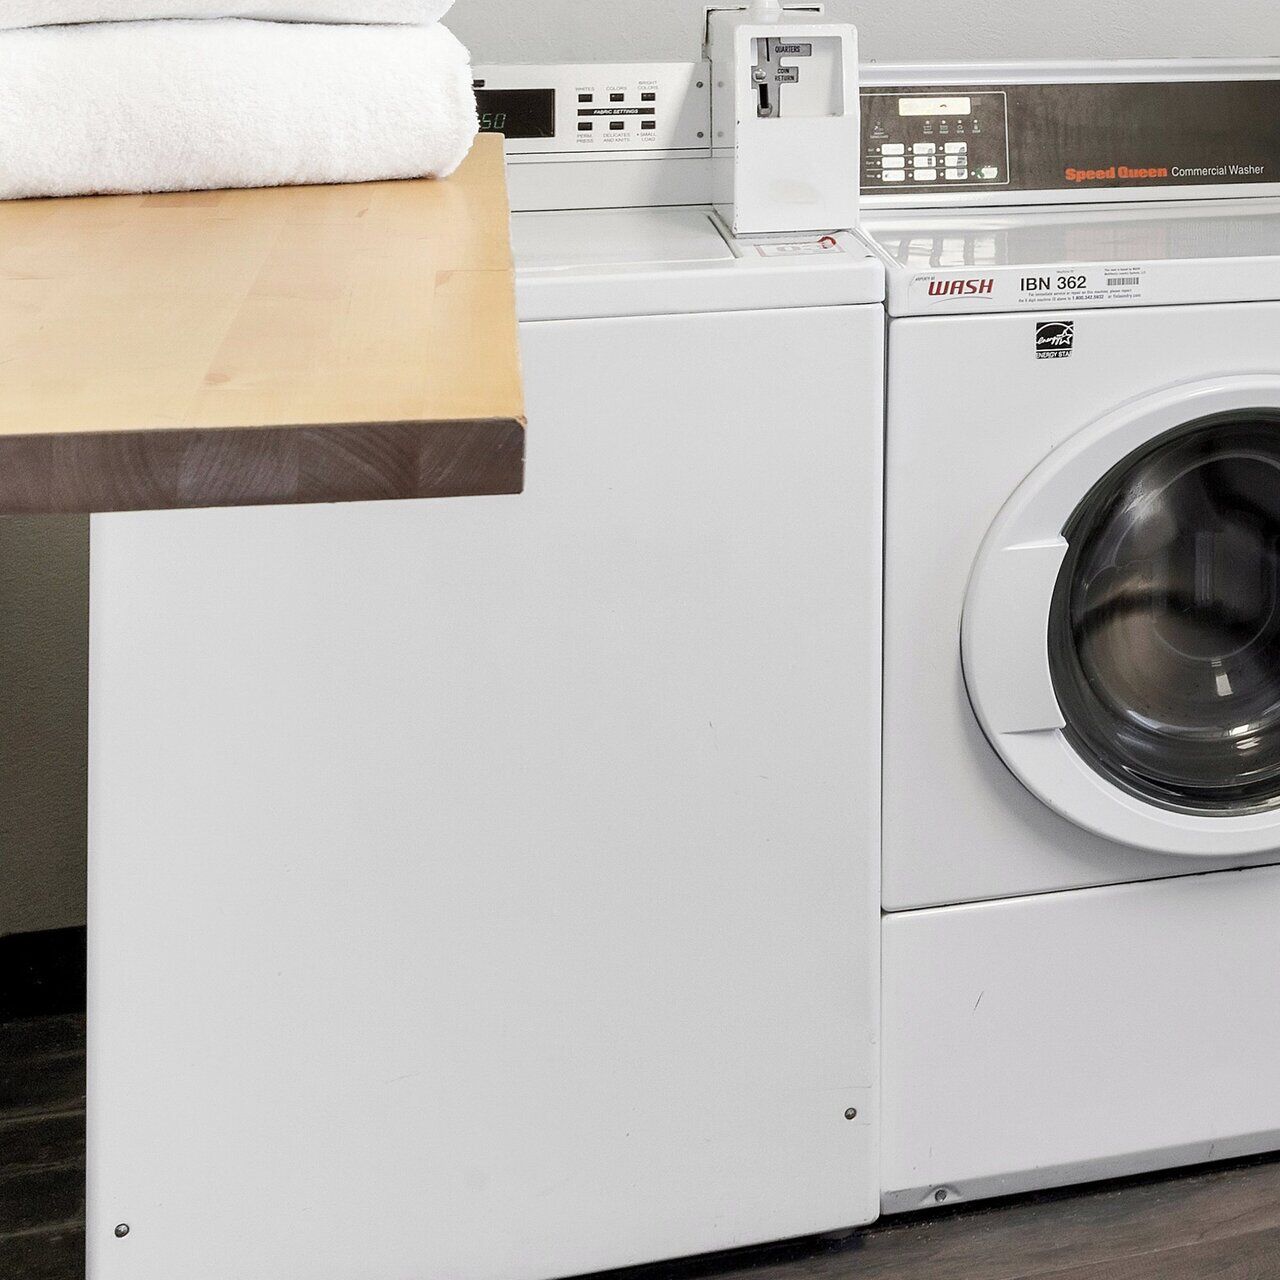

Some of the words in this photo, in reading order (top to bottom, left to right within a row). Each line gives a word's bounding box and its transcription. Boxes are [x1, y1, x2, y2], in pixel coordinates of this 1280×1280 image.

[774, 45, 801, 54] QUARTERS
[1065, 166, 1116, 183] Speed
[1117, 166, 1168, 179] Queen
[1171, 165, 1227, 178] Commercial
[1229, 164, 1265, 175] Washer
[928, 278, 994, 296] WASH
[1020, 277, 1051, 291] IBN
[1057, 275, 1087, 290] 362
